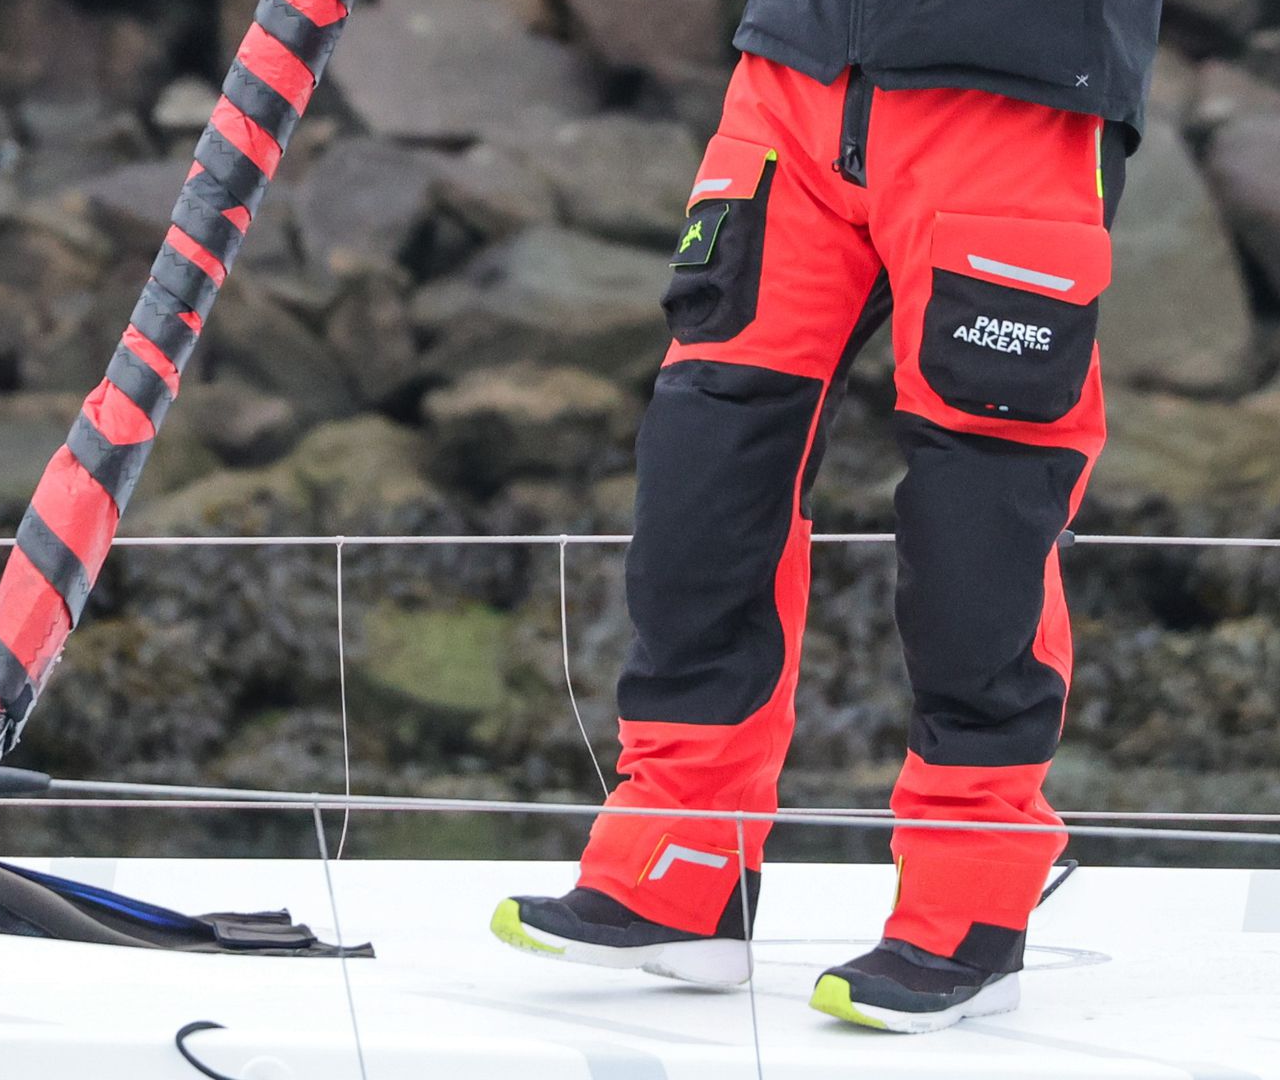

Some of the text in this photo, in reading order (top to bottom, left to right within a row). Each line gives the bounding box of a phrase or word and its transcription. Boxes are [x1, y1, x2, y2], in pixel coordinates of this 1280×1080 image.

[953, 325, 1050, 355] ARKEA TEAM
[974, 316, 1052, 344] PAPREC
